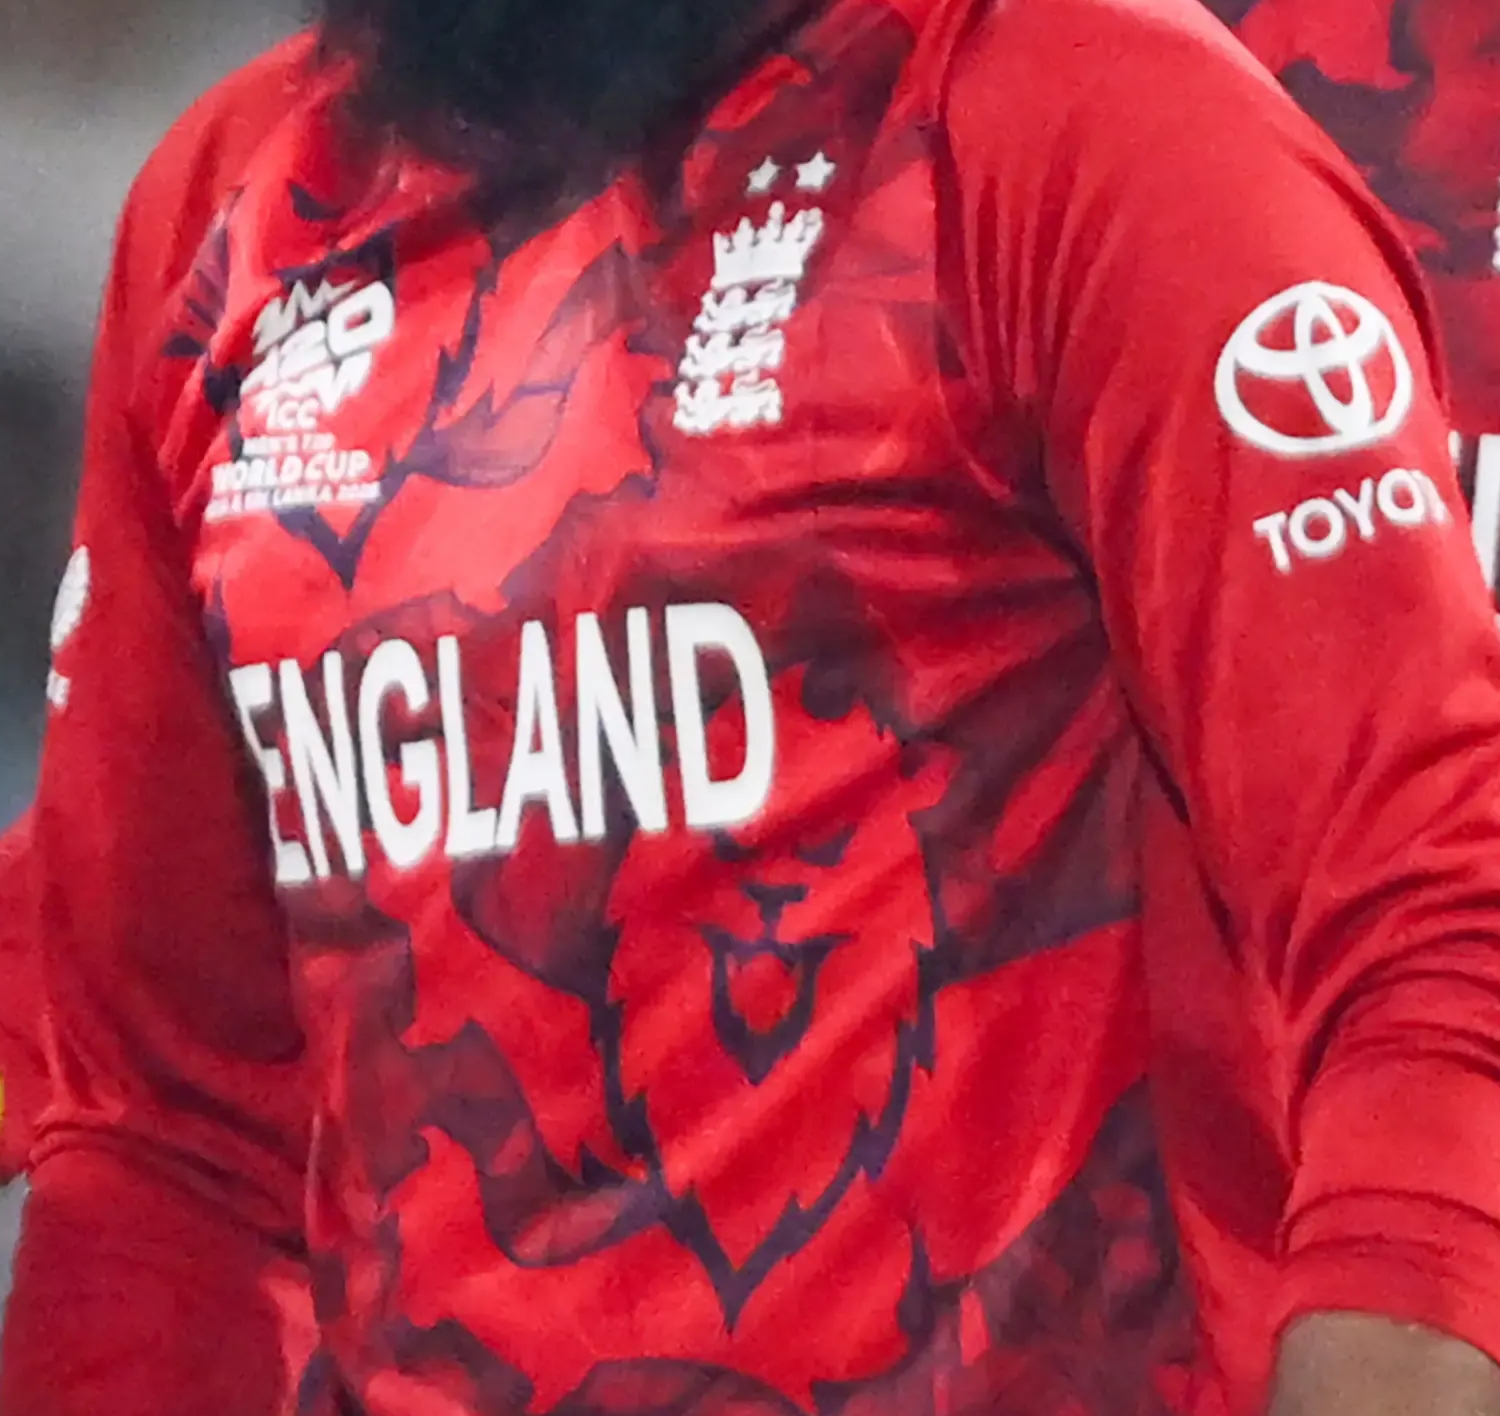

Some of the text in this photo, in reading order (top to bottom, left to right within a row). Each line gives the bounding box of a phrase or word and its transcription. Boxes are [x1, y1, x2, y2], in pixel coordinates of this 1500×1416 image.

[266, 397, 319, 430] ICC
[210, 448, 370, 494] WORLD CUP
[230, 601, 776, 886] ENGLAND
